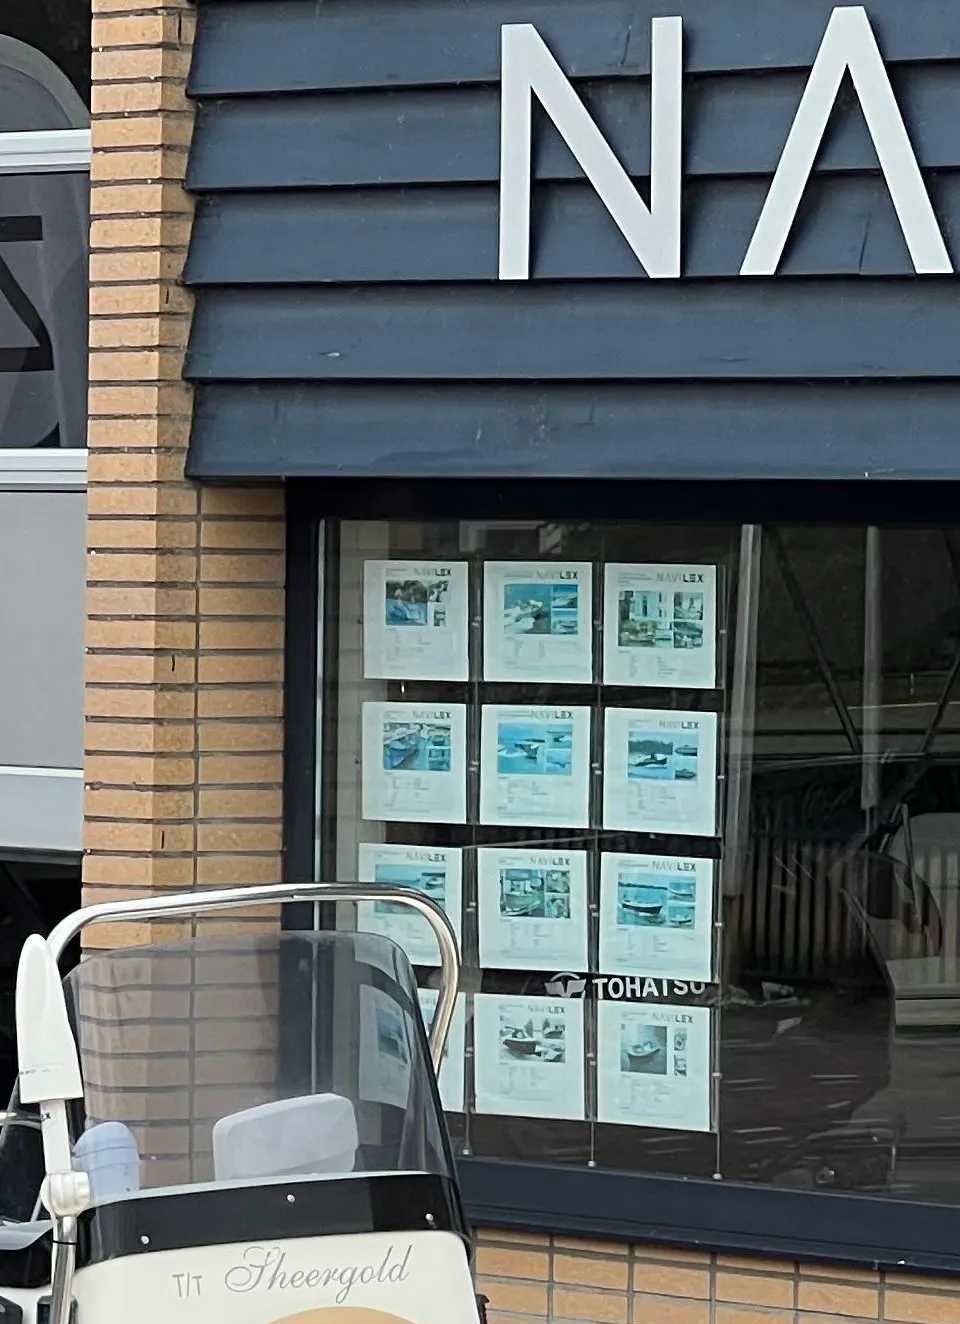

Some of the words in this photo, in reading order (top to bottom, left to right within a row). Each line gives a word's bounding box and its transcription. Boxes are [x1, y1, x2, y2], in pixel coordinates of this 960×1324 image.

[414, 568, 452, 577] NAVILEX
[536, 571, 578, 580] NAVILEX
[655, 572, 704, 583] NAVILEX
[412, 711, 452, 719] NAVILEX
[530, 710, 573, 720] NAVILEX
[659, 720, 700, 729] NAVILEX
[405, 853, 447, 862] NAVILEX
[529, 857, 570, 866] NAVILEX
[651, 861, 697, 872] NAVILEX
[592, 977, 705, 999] TOHATSU
[652, 1012, 694, 1024] NAVILEX
[225, 1245, 412, 1304] Sheergold
